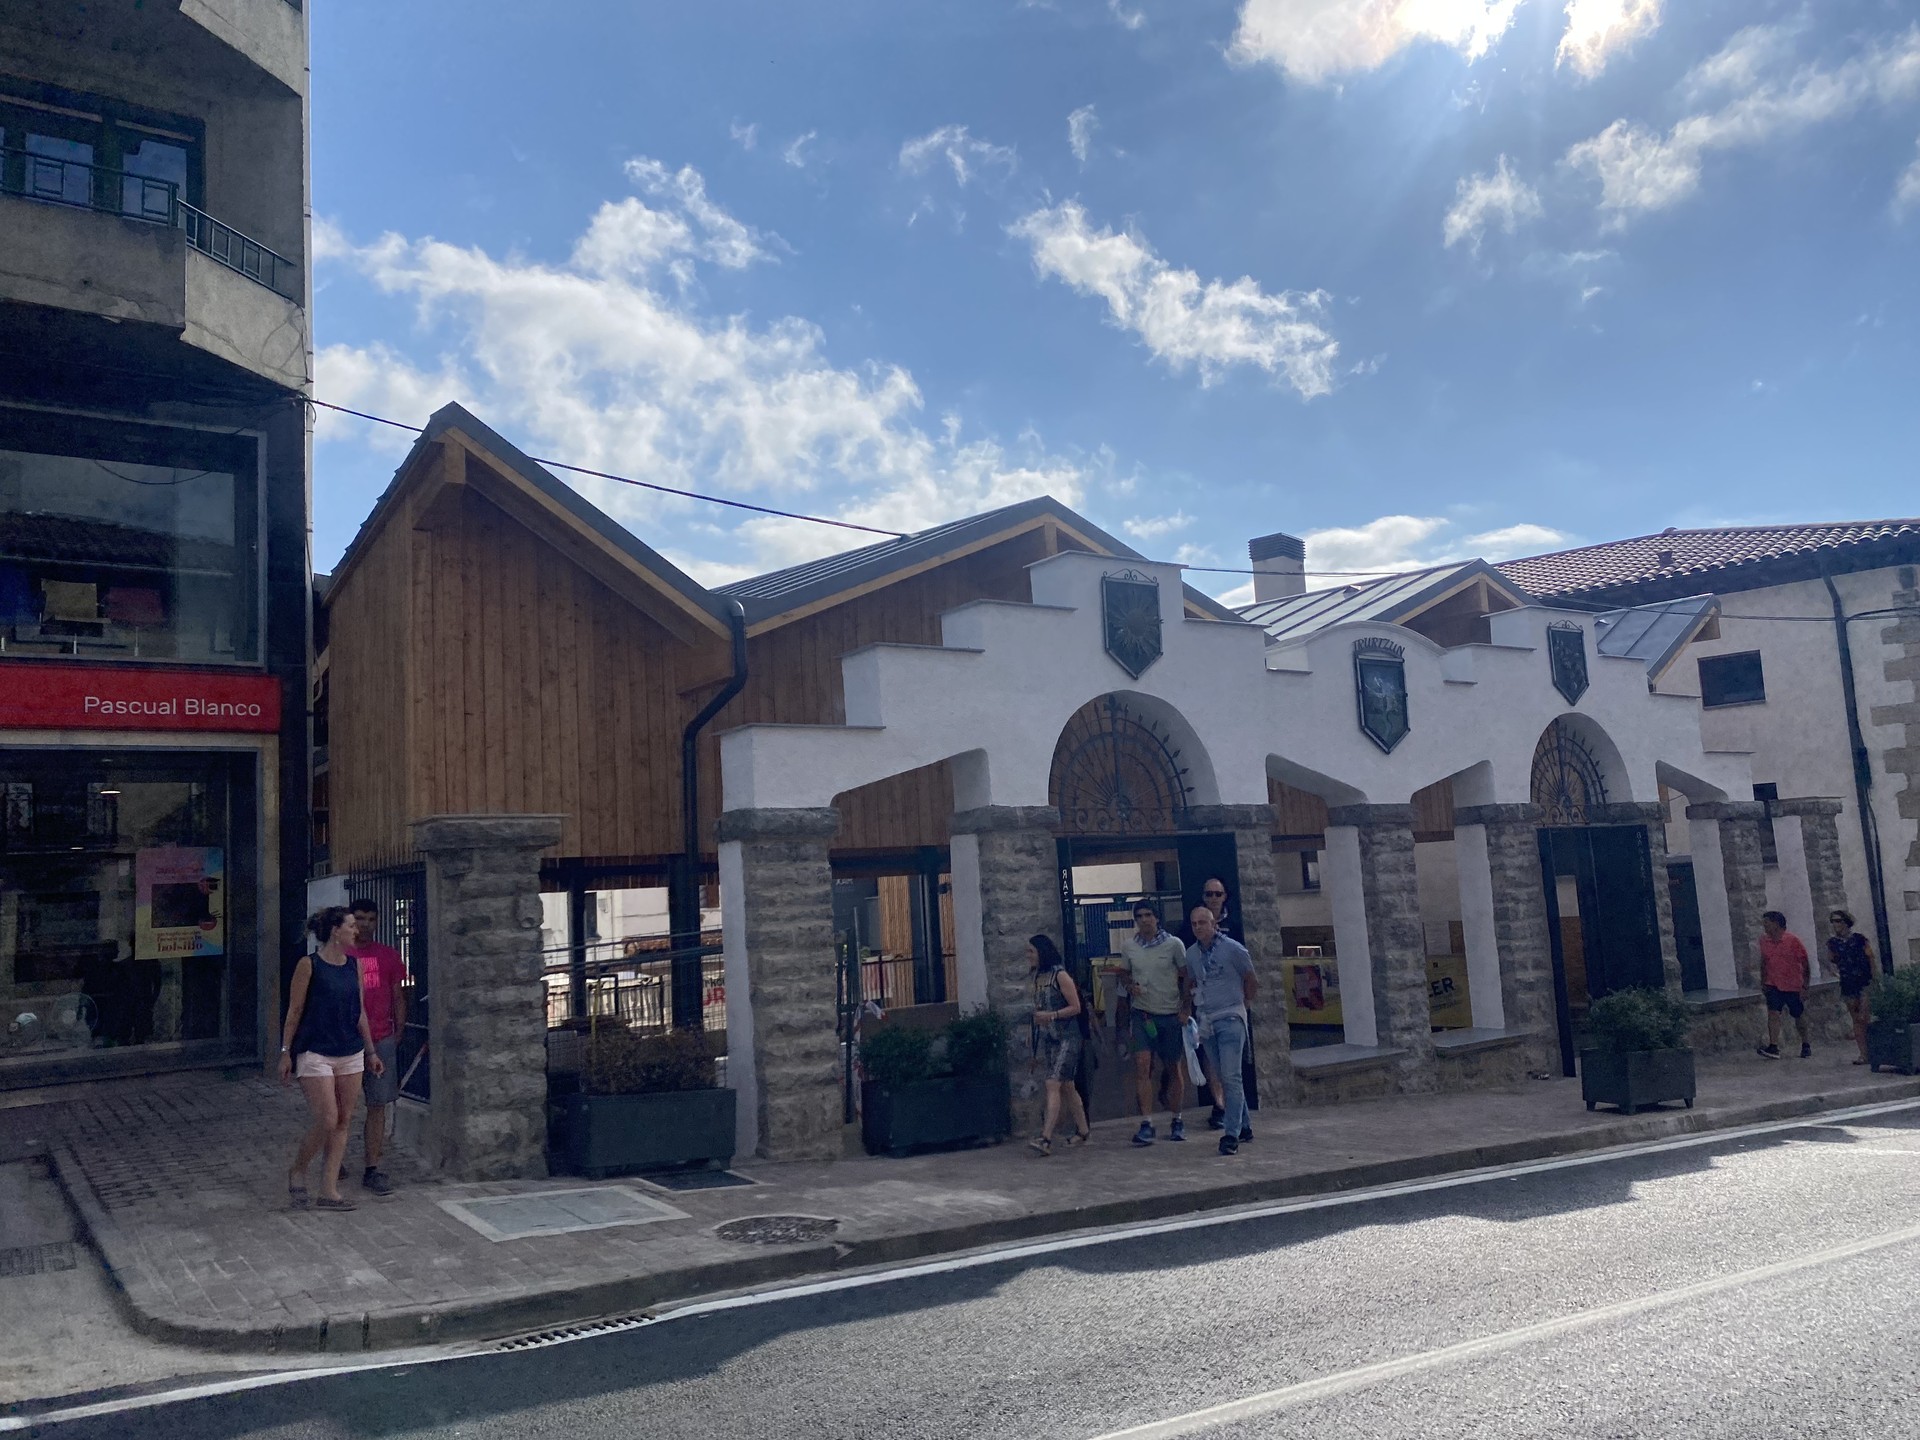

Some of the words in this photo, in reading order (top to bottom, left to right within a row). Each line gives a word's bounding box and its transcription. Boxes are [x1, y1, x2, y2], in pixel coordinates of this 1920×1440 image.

[1352, 637, 1405, 659] IRURTZUN
[84, 696, 177, 715] Pascual
[184, 698, 261, 716] Blanco
[1429, 976, 1456, 997] ER
